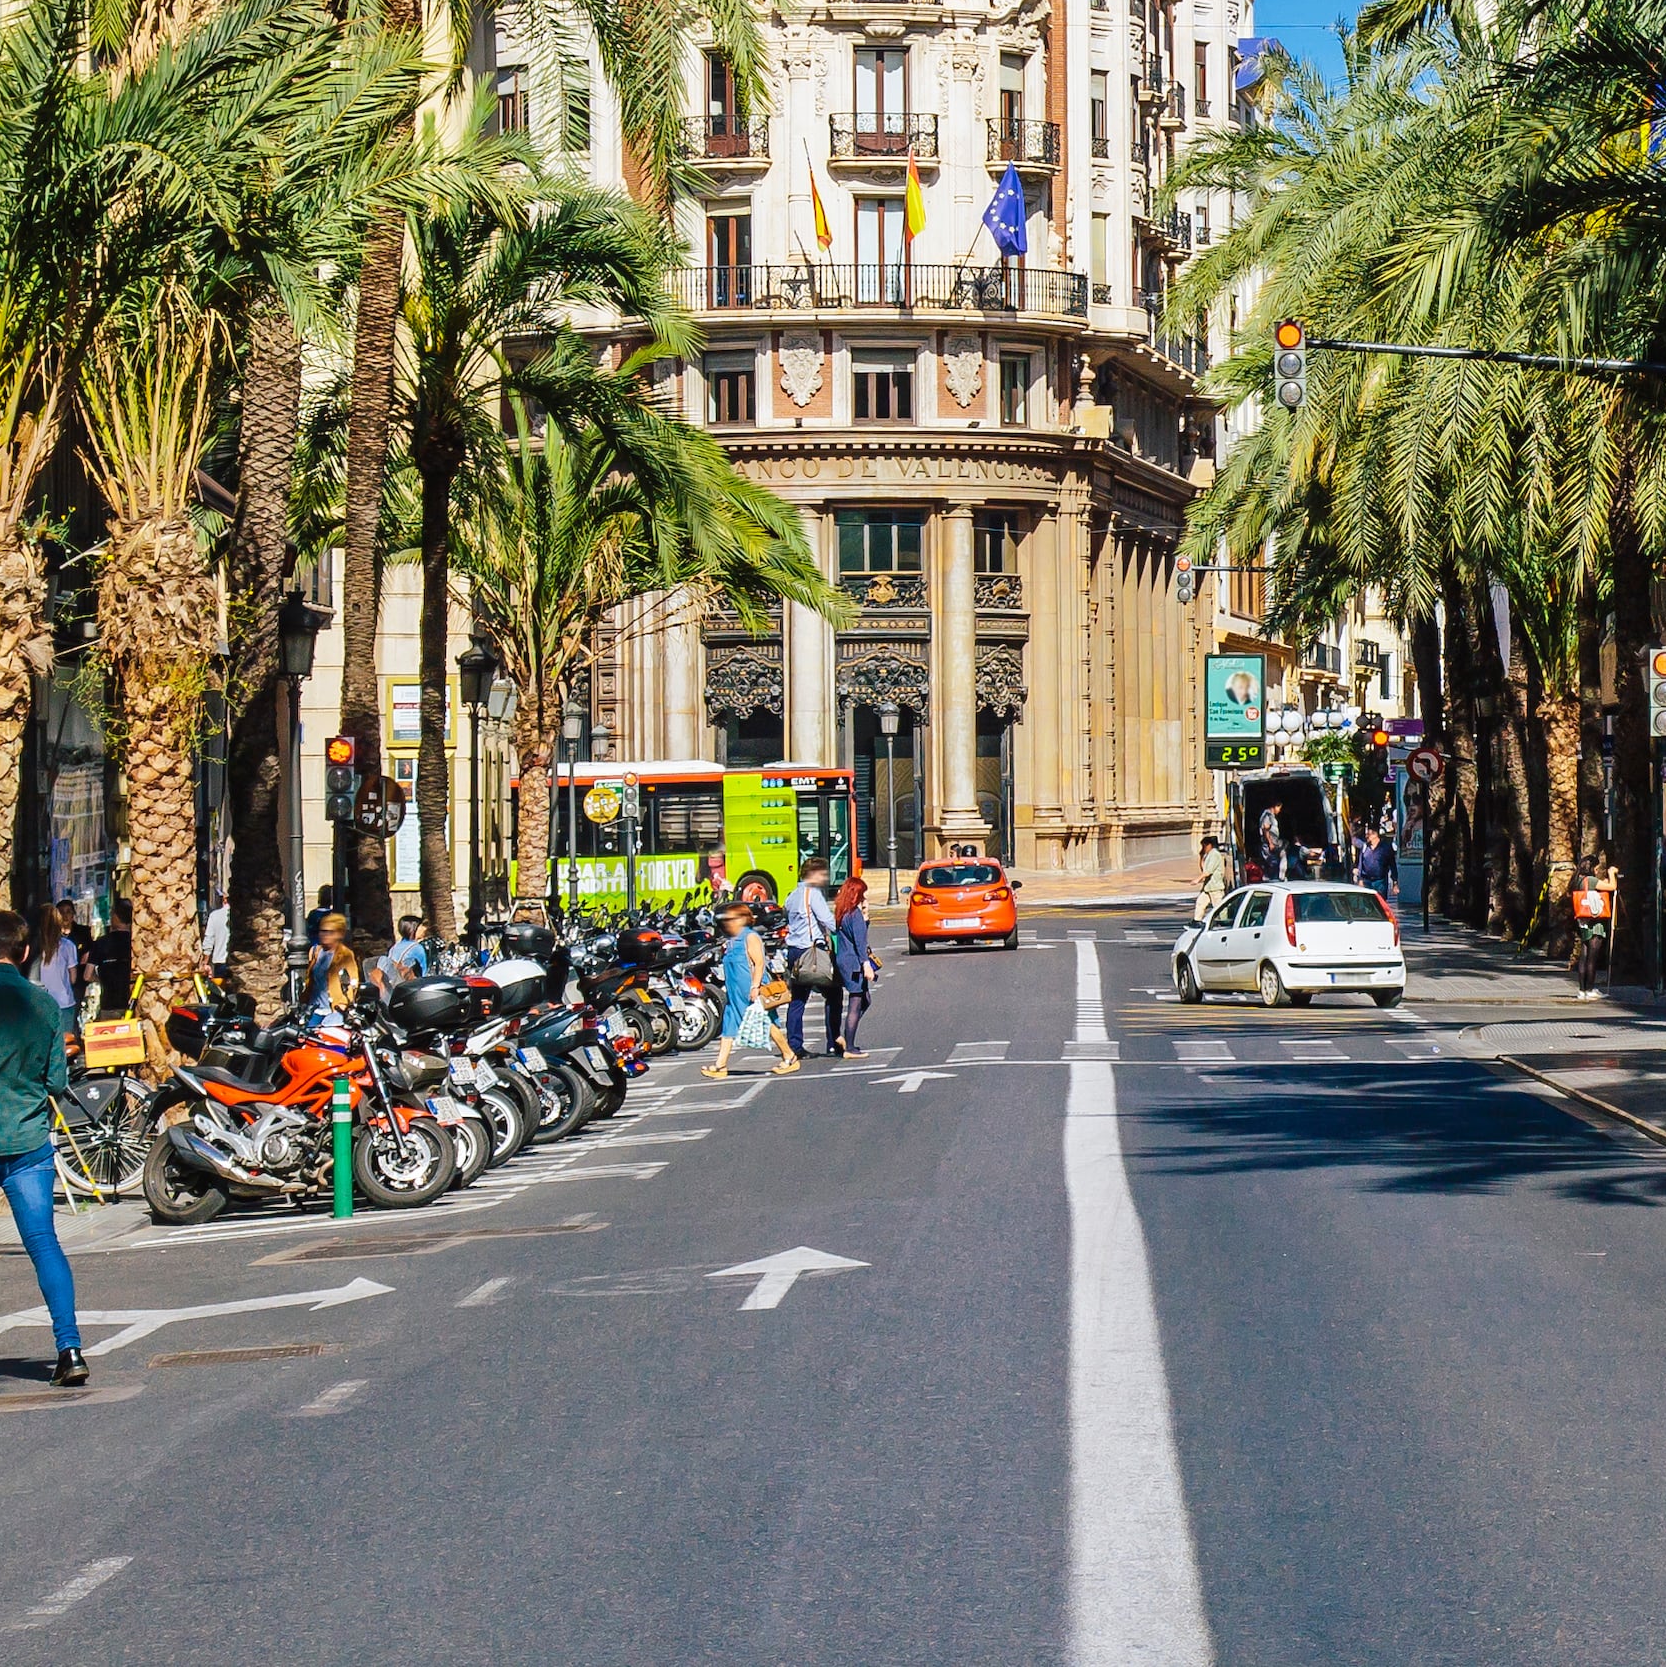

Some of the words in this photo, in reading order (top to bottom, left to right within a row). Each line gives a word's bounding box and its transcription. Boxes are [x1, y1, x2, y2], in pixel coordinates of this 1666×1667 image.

[735, 457, 821, 480] ANCO
[837, 456, 878, 479] DE
[893, 456, 1031, 481] VALENCIA
[790, 777, 817, 786] EMT
[640, 858, 696, 892] FOREVER
